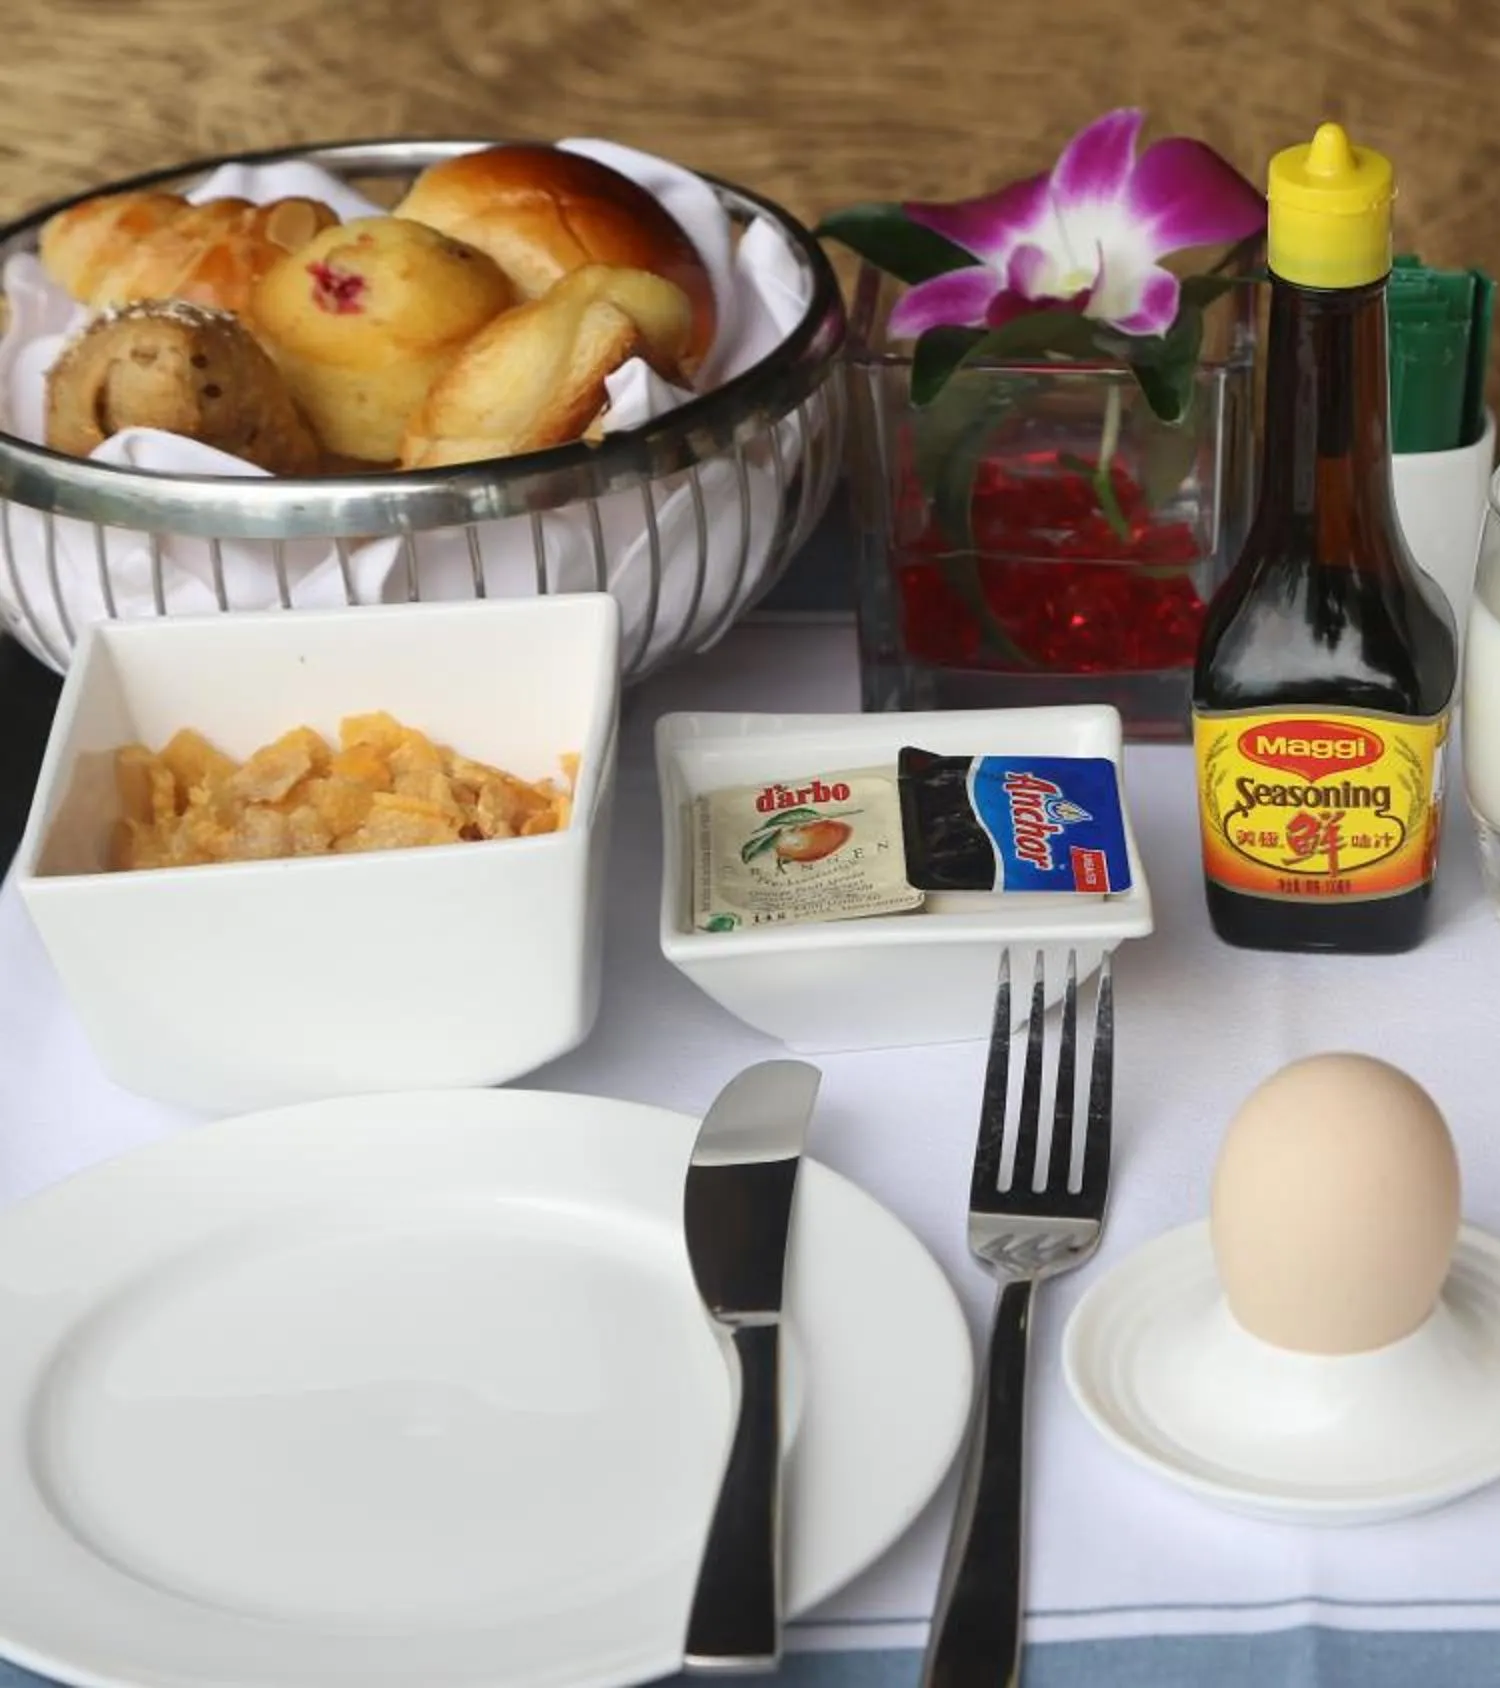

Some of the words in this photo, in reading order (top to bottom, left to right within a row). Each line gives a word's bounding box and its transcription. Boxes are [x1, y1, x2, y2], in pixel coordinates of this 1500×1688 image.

[1256, 735, 1366, 760] Maggi
[1235, 776, 1391, 817] Seasoning
[1003, 771, 1062, 870] Anchor
